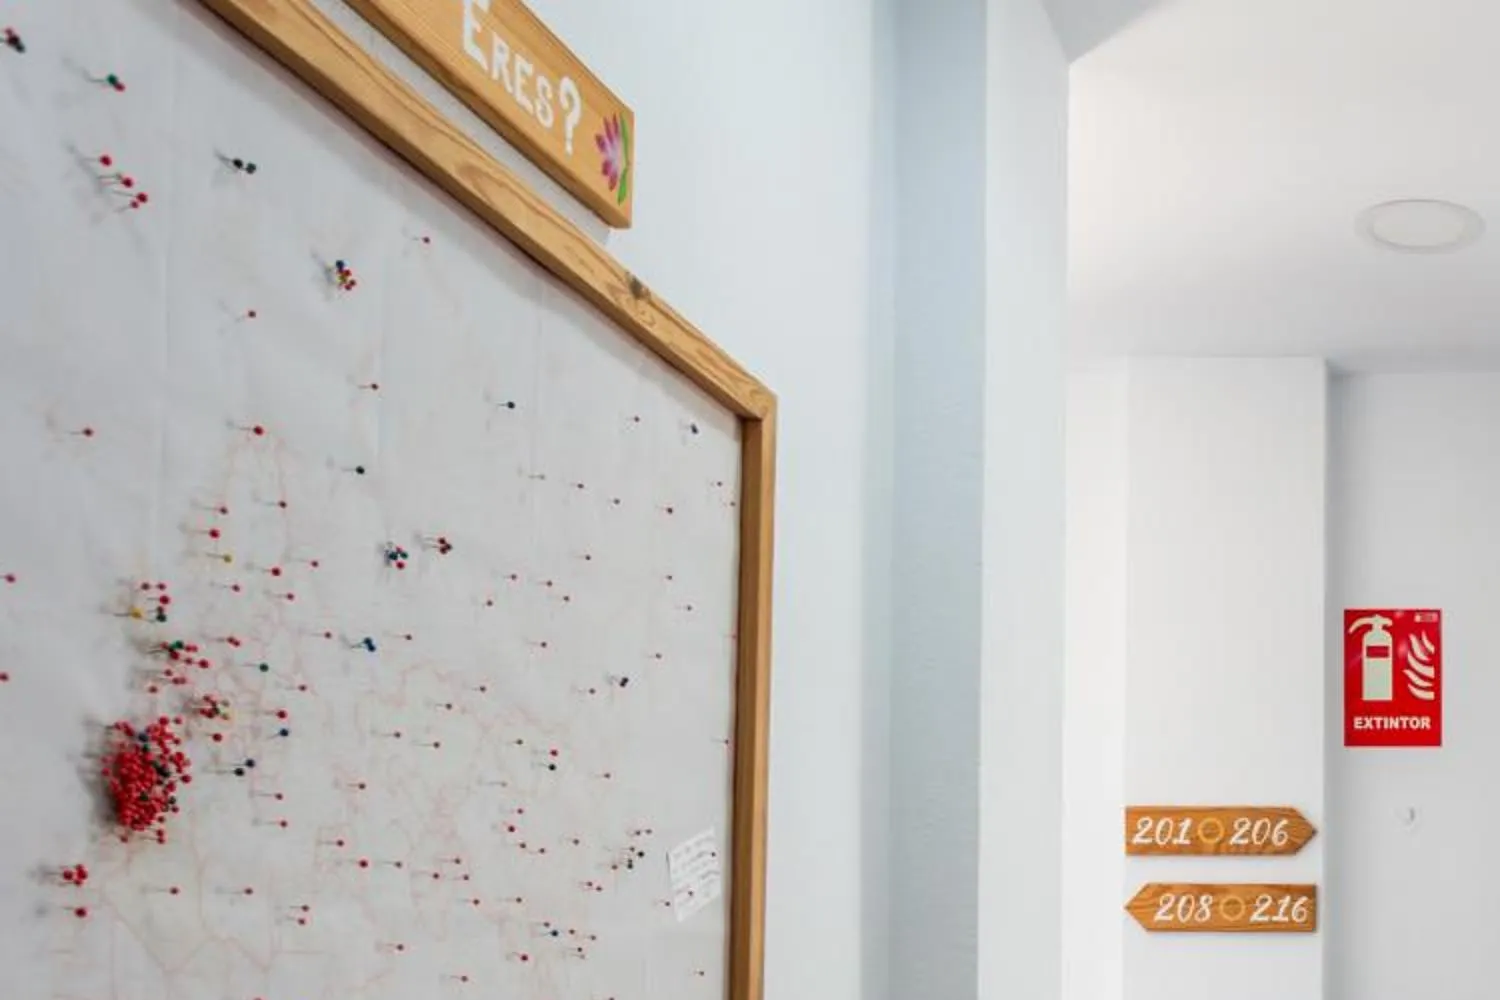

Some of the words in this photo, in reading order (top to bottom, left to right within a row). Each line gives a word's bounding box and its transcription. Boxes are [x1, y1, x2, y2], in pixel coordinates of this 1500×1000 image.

[1353, 715, 1431, 730] EXTINTOR
[1132, 816, 1193, 846] 201
[1229, 816, 1289, 846] 206
[1154, 893, 1214, 923] 208
[1249, 893, 1309, 923] 216
